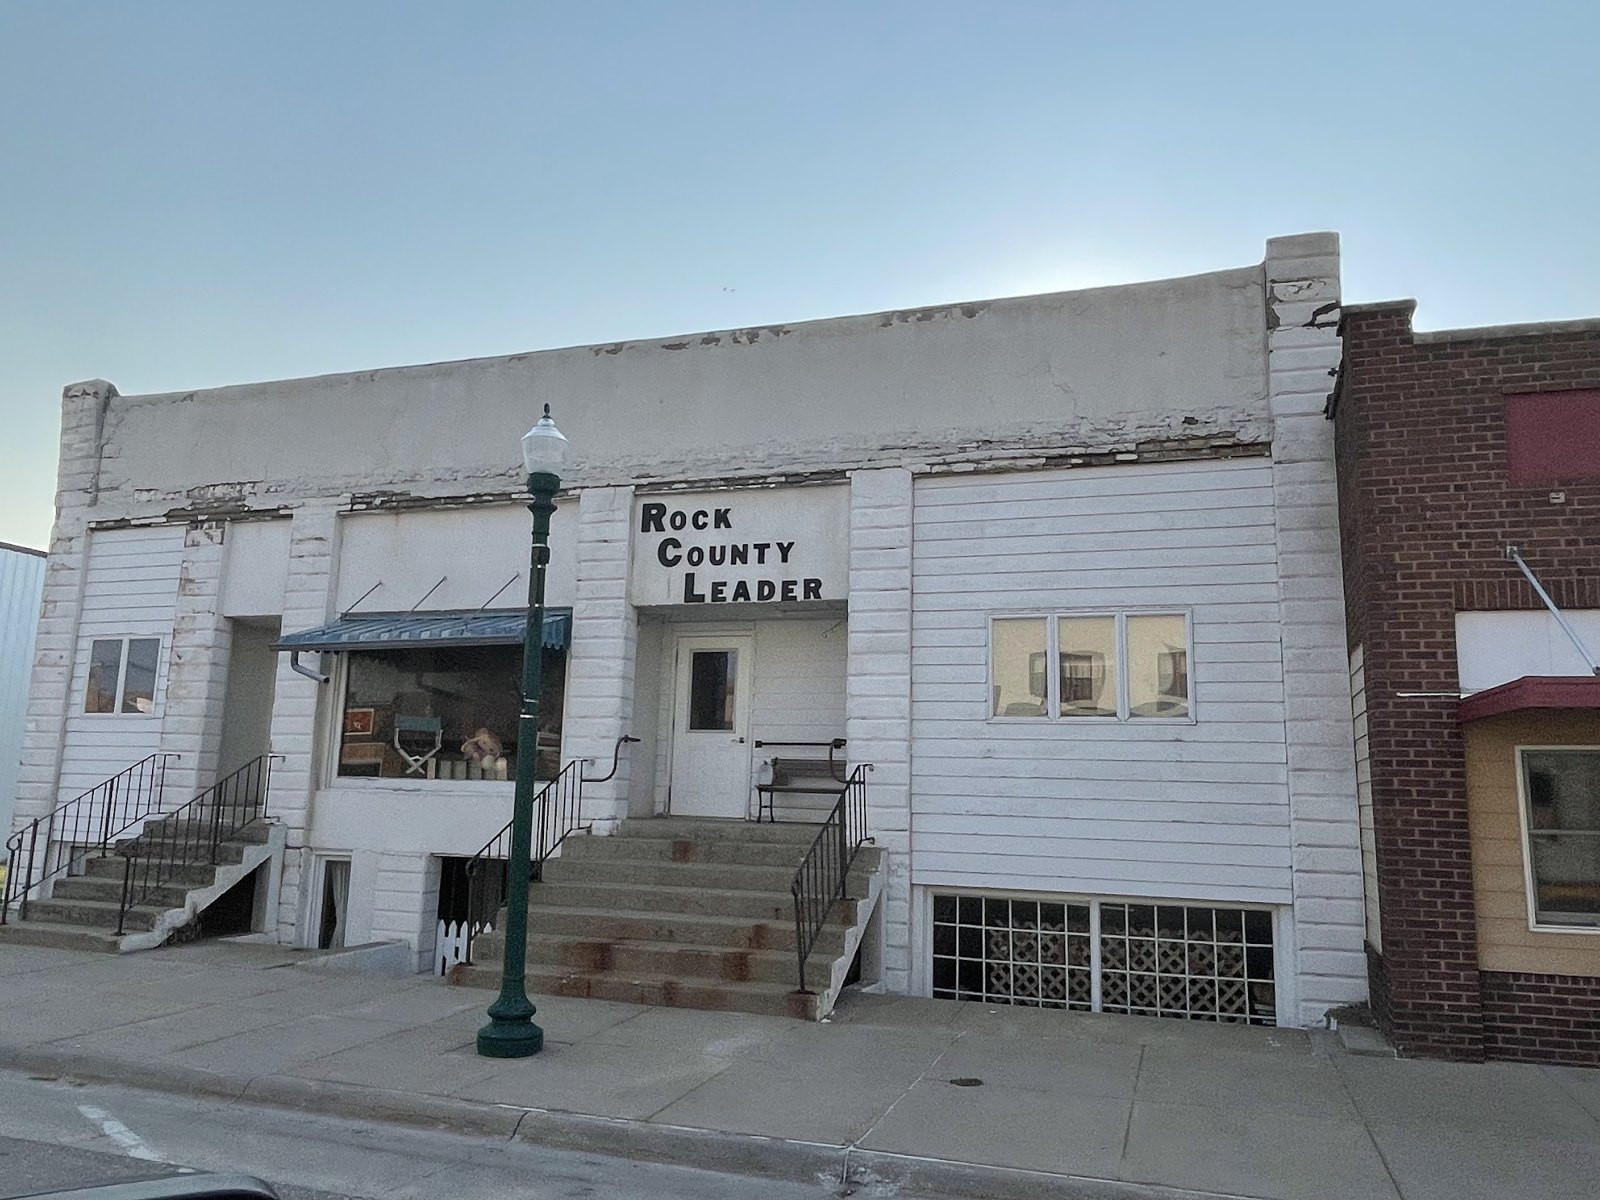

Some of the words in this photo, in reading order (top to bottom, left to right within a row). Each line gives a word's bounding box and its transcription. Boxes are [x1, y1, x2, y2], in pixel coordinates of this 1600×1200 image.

[641, 503, 732, 532] ROCK
[657, 537, 795, 567] COUNTY
[684, 572, 822, 603] LEADER
